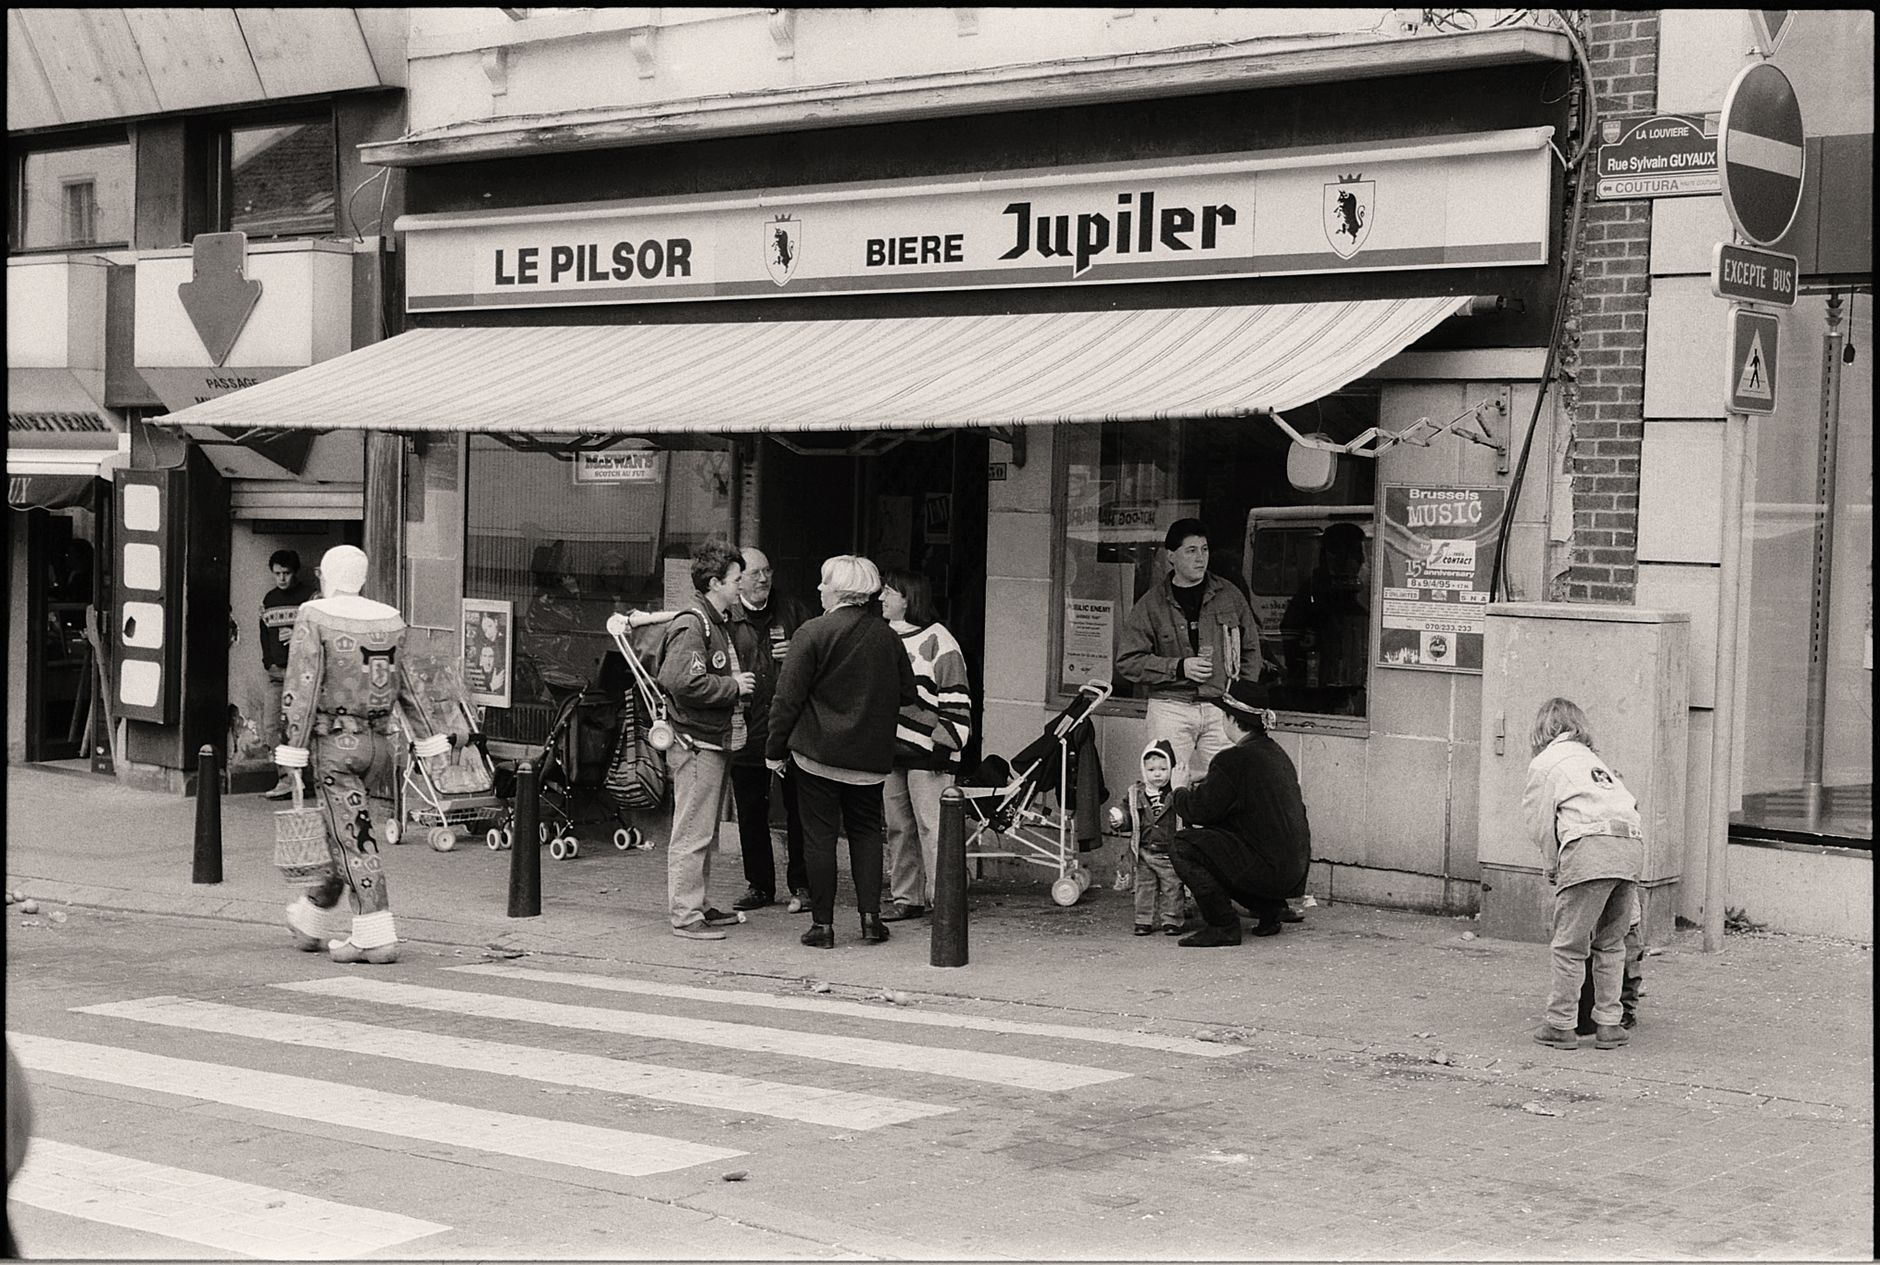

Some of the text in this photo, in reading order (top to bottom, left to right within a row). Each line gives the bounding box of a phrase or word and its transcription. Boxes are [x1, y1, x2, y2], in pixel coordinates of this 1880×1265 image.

[1636, 130, 1647, 139] LA
[1607, 152, 1716, 172] Rue Sylvain GUYAUX
[1615, 180, 1679, 193] COUTURA
[866, 191, 1237, 276] BIERE Jupiler
[495, 238, 692, 285] LE PILSOR
[1724, 259, 1792, 293] EXCEPTE BUS
[206, 378, 259, 389] PASSAGE
[594, 470, 619, 478] SCOTCH
[1409, 488, 1479, 500] Brussels
[1406, 500, 1482, 528] MUSIC
[1442, 556, 1472, 565] CONTACT
[1423, 570, 1475, 579] anniversary
